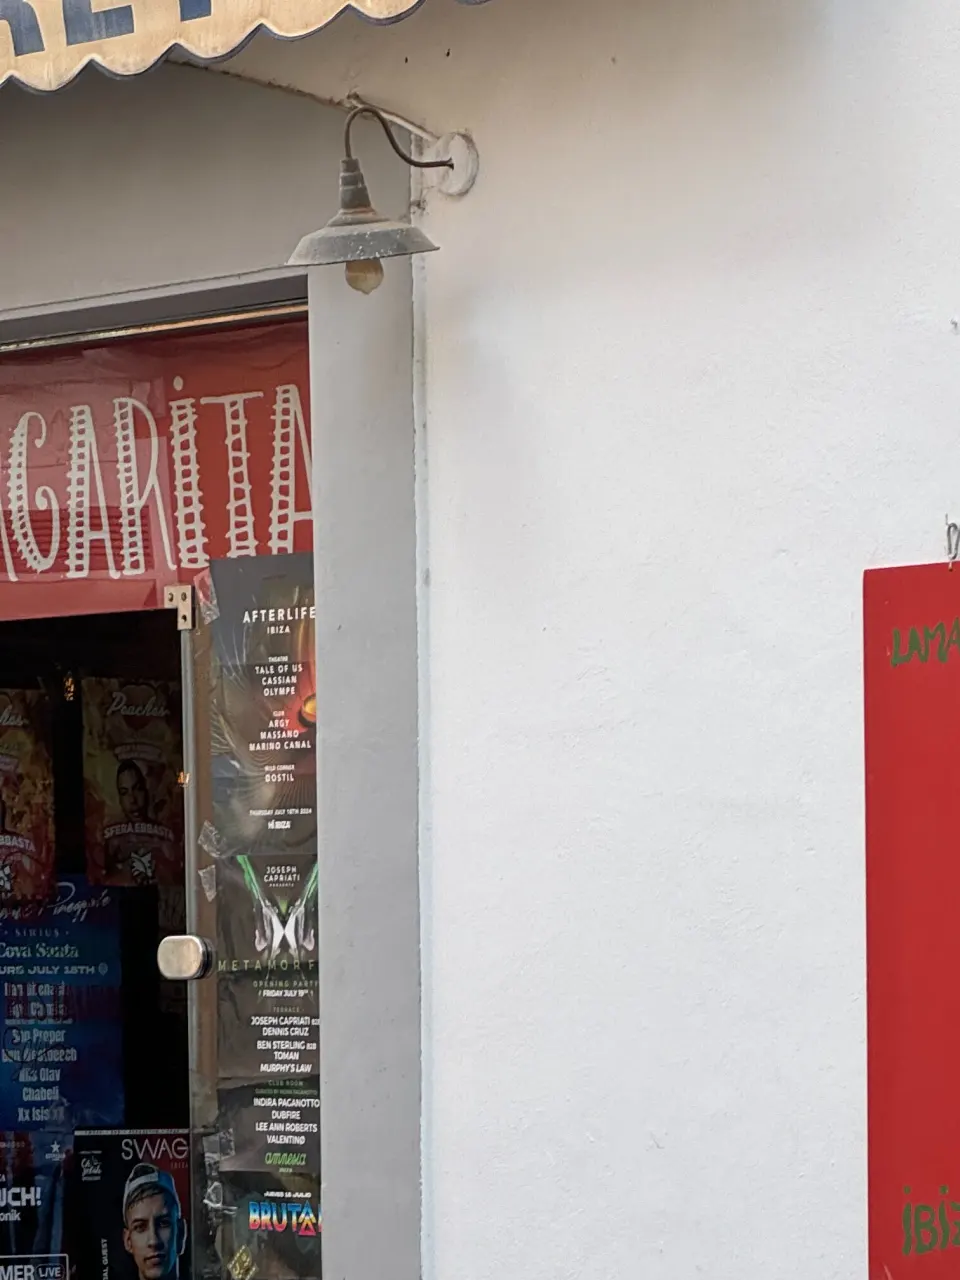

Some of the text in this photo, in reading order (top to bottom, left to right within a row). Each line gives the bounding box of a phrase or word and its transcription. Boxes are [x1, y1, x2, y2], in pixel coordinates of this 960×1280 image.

[243, 606, 316, 624] AFTERLIFE
[267, 625, 291, 635] IBIZA
[255, 663, 303, 675] TALE OF US
[261, 675, 297, 686] CASSIAN
[263, 686, 296, 697] OLYMPE
[268, 719, 290, 729] ARGY
[260, 730, 300, 740] MASSANO
[249, 740, 312, 752] MARINO CANAL
[266, 865, 297, 874] JOSEPH
[264, 874, 301, 883] CAPRIATI
[35, 942, 80, 959] Santa
[27, 965, 60, 975] JULY
[252, 980, 290, 989] OPENING
[250, 1016, 278, 1026] JOSEPH
[279, 1016, 311, 1026] CAPRIATI
[262, 1026, 310, 1037] DENNIS CRUZ
[256, 1040, 272, 1050] BEN
[273, 1040, 306, 1051] STERLING
[273, 1051, 300, 1061] TOMAN
[260, 1063, 313, 1073] MURPHY'S LAW
[253, 1097, 320, 1108] INDIRA PAGANOTTO
[271, 1110, 301, 1120] DUBFIRE
[255, 1121, 318, 1133] LEE ANN ROBERTS
[266, 1134, 306, 1145] VALENTINO
[121, 1137, 188, 1161] SWAG
[38, 1266, 61, 1278] LIVE
